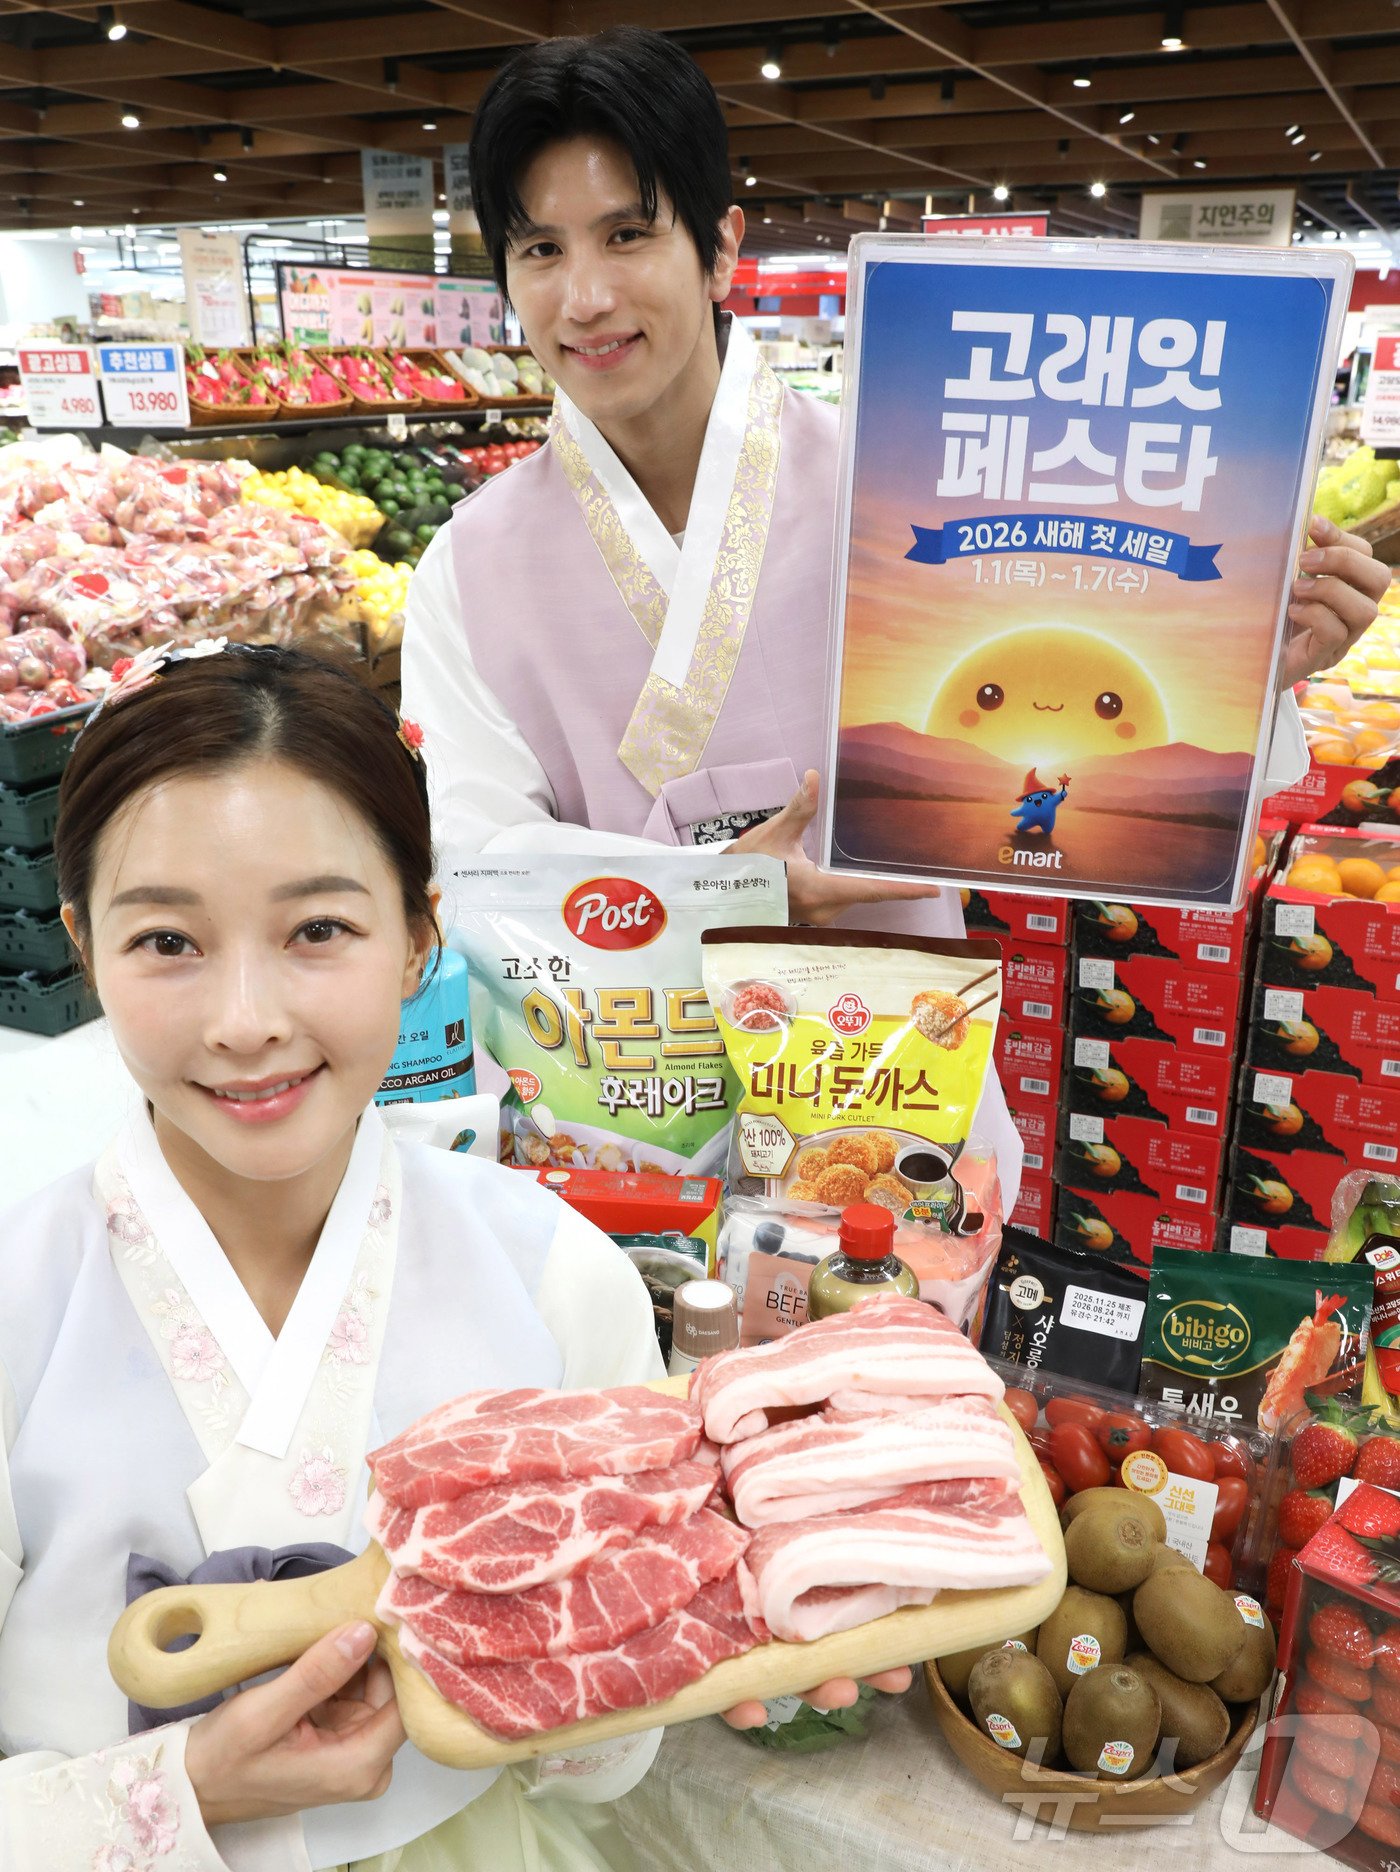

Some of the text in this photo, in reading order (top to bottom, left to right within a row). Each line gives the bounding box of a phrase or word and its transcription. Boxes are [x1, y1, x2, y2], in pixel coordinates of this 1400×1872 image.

[108, 350, 167, 372] 추천상품
[944, 310, 1227, 411] 고래잇
[61, 397, 95, 415] 4,980
[128, 391, 178, 413] 13,980
[936, 411, 1219, 512] 페스타
[957, 520, 1174, 566] 2026 새해 첫 세일
[971, 558, 1046, 588] 1.1(목)
[1071, 565, 1150, 594] 1.7(수)
[998, 845, 1063, 869] emart
[693, 878, 770, 891] 좋은아침! 좋은생각!
[574, 892, 653, 936] Post
[501, 955, 571, 982] 고소한
[1036, 965, 1056, 979] 감귤
[521, 986, 725, 1070] 아몬드
[836, 1015, 863, 1027] 오뚜기
[409, 1030, 429, 1043] 오일
[810, 1039, 845, 1061] 육즙
[1033, 1042, 1053, 1056] 감귤
[401, 1055, 443, 1069] SHAMPOO
[664, 1061, 723, 1072] Almond Flakes
[404, 1071, 439, 1087] ARGAN
[440, 1067, 457, 1079] OIL
[751, 1061, 940, 1112] 미니 돈까스
[597, 1075, 728, 1118] 후레이크
[827, 1113, 847, 1121] PORK
[848, 1115, 876, 1123] CUTLET
[759, 1128, 786, 1147] 100%
[750, 1150, 774, 1159] 돼지고기
[912, 1207, 932, 1218] 8분
[1182, 1225, 1202, 1239] 감귤
[1374, 1249, 1393, 1263] Dole
[780, 1284, 798, 1294] TRUE
[1015, 1284, 1039, 1302] 고메
[766, 1290, 809, 1317] BEF
[1071, 1300, 1131, 1321] 2026.08.24 까지
[1073, 1292, 1132, 1312] 2025.11.25 제조
[1093, 1314, 1116, 1326] 21:42
[1170, 1313, 1245, 1348] bibigo
[1182, 1338, 1213, 1351] 비비고
[1169, 1484, 1196, 1503] 신선
[1163, 1496, 1196, 1515] 그대로
[1172, 1538, 1193, 1550] 국내산
[1236, 1597, 1261, 1611] Zespri
[1072, 1639, 1100, 1656] Zespri
[987, 1719, 1014, 1731] Zespri
[1103, 1742, 1134, 1759] Zespri
